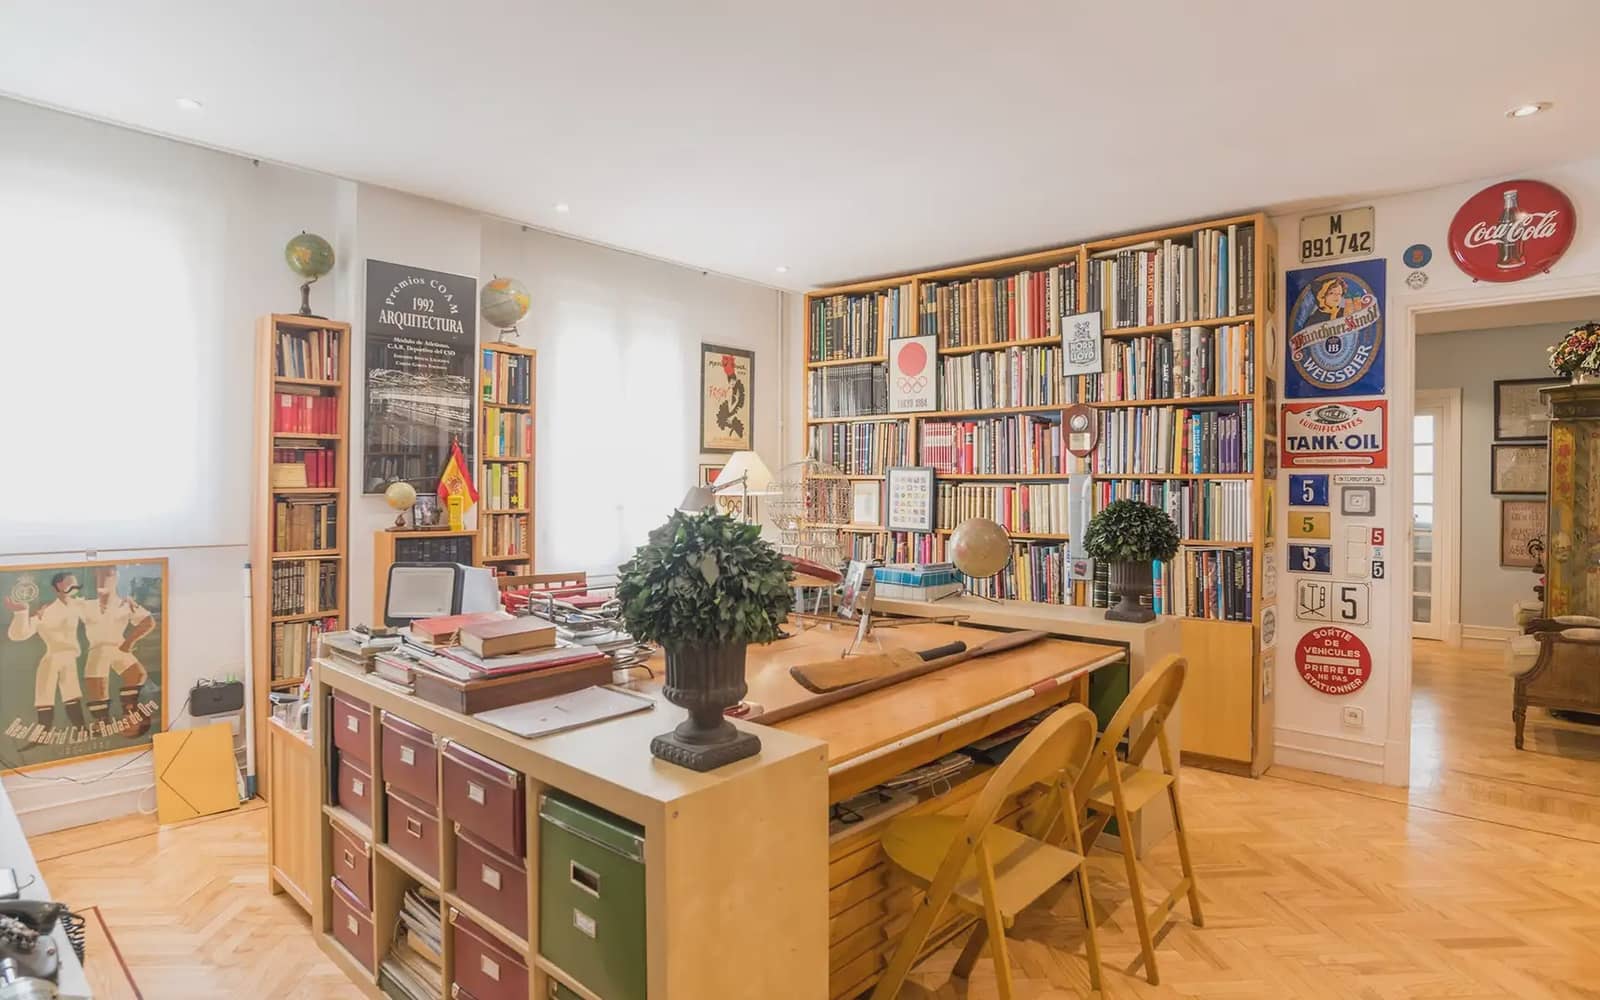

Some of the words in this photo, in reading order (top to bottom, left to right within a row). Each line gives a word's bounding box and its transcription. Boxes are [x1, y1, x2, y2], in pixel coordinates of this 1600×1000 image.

[1330, 214, 1341, 235] M
[1302, 231, 1371, 258] 891742
[385, 275, 425, 306] Premios
[430, 279, 458, 315] COAM
[413, 297, 434, 313] 1992
[379, 309, 464, 334] ARQUITECTURA
[1303, 345, 1373, 383] WEISSBIER
[1299, 417, 1364, 433] LUBRIFICANTES
[1302, 479, 1314, 502] 5
[1302, 516, 1314, 533] 5
[1373, 530, 1382, 544] 5
[1302, 547, 1317, 570] 5
[1373, 562, 1383, 577] 5
[1341, 587, 1357, 620] 5
[1313, 628, 1352, 642] SORTIE
[1324, 639, 1340, 647] DE
[1347, 668, 1363, 676] DE
[1304, 673, 1363, 694] STATIONNER
[5, 717, 32, 739] Real
[30, 722, 68, 745] Madrid
[99, 717, 130, 738] Bodas
[129, 709, 140, 725] de
[137, 699, 160, 718] Oro
